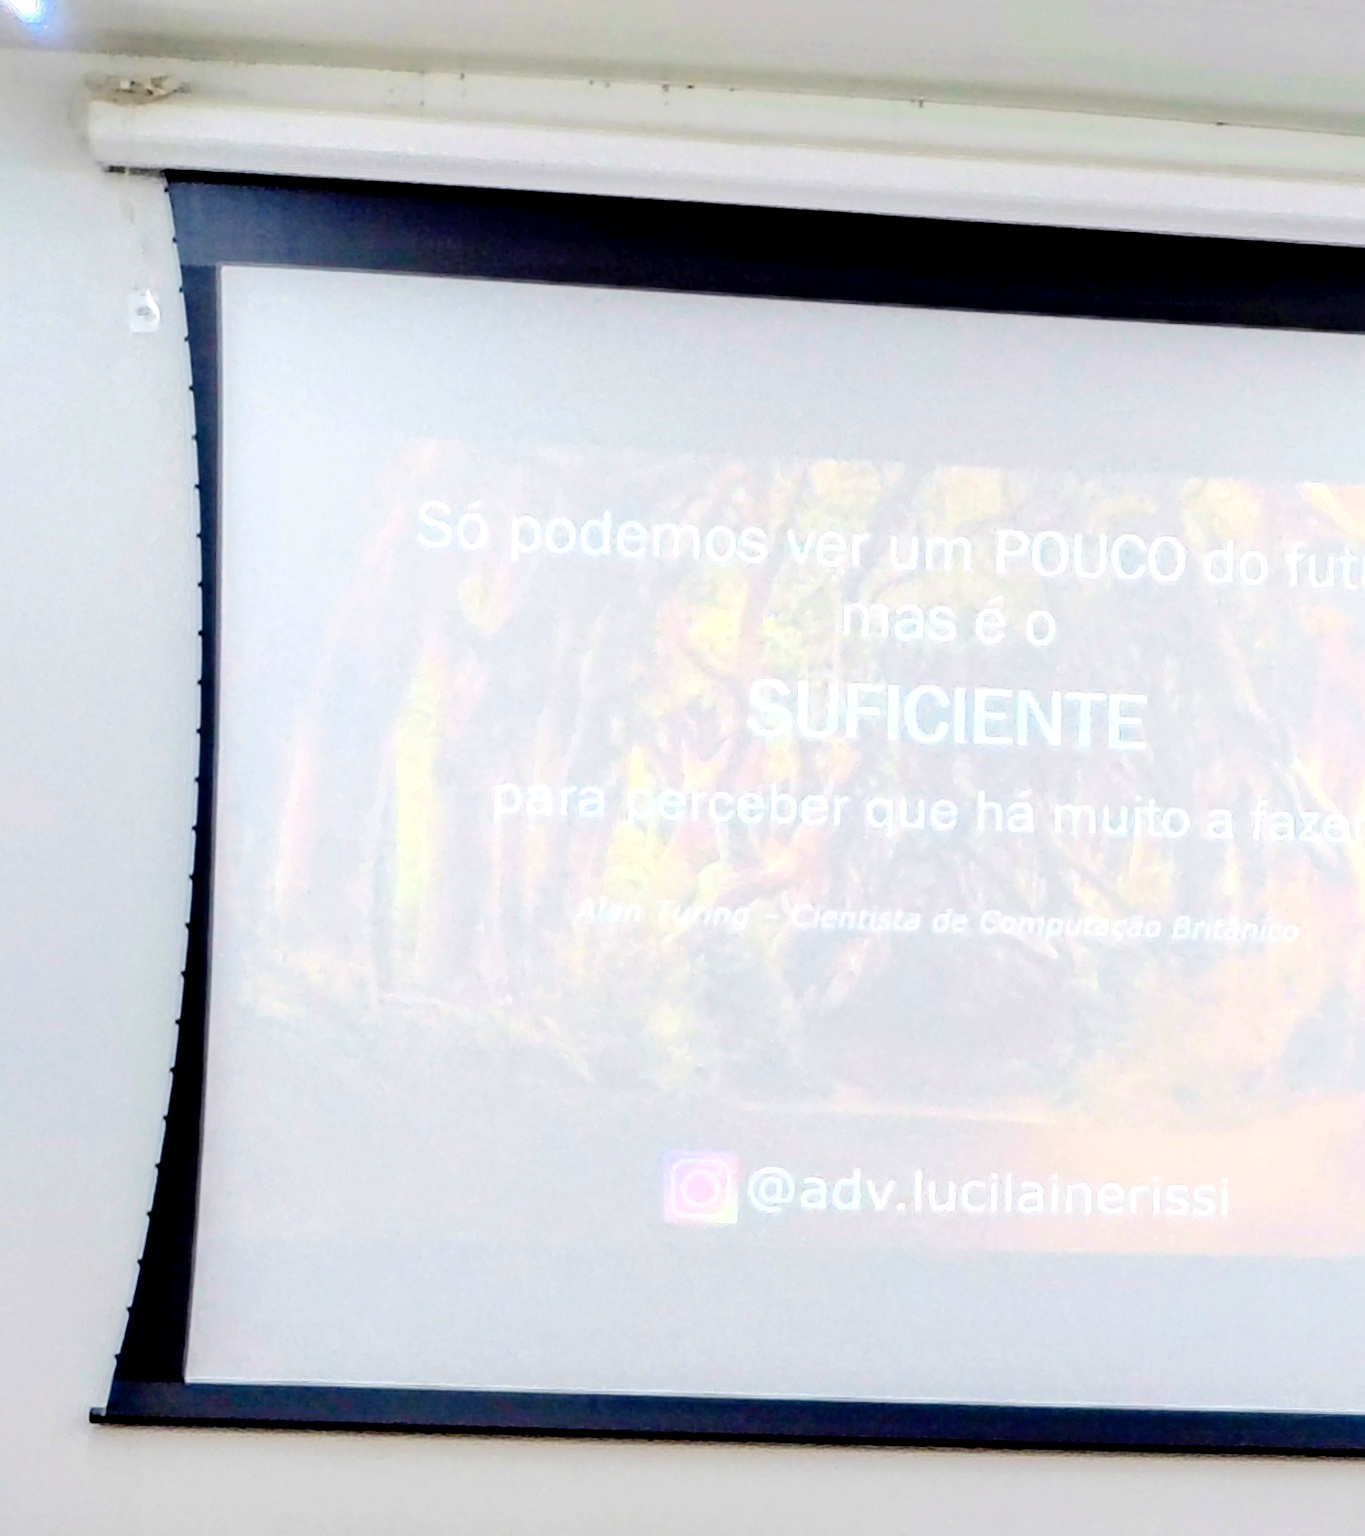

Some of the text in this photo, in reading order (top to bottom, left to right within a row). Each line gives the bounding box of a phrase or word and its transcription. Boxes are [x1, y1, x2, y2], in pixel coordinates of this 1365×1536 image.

[415, 497, 491, 553] Só
[508, 508, 770, 565] podemos
[787, 530, 869, 570] ver
[887, 538, 973, 573] um
[995, 529, 1188, 586] POUCO
[1203, 541, 1270, 587] do
[842, 594, 1056, 646] mas é o
[745, 677, 1149, 752] SUFICIENTE
[492, 782, 607, 824] para
[626, 783, 851, 826] perceber
[865, 797, 961, 837] que
[976, 788, 1037, 836] há
[1053, 797, 1191, 839] muito
[1205, 805, 1236, 840] a
[791, 902, 922, 932] Cientista
[932, 908, 969, 934] de
[746, 1165, 1231, 1219] @adv.lucilainerissi
